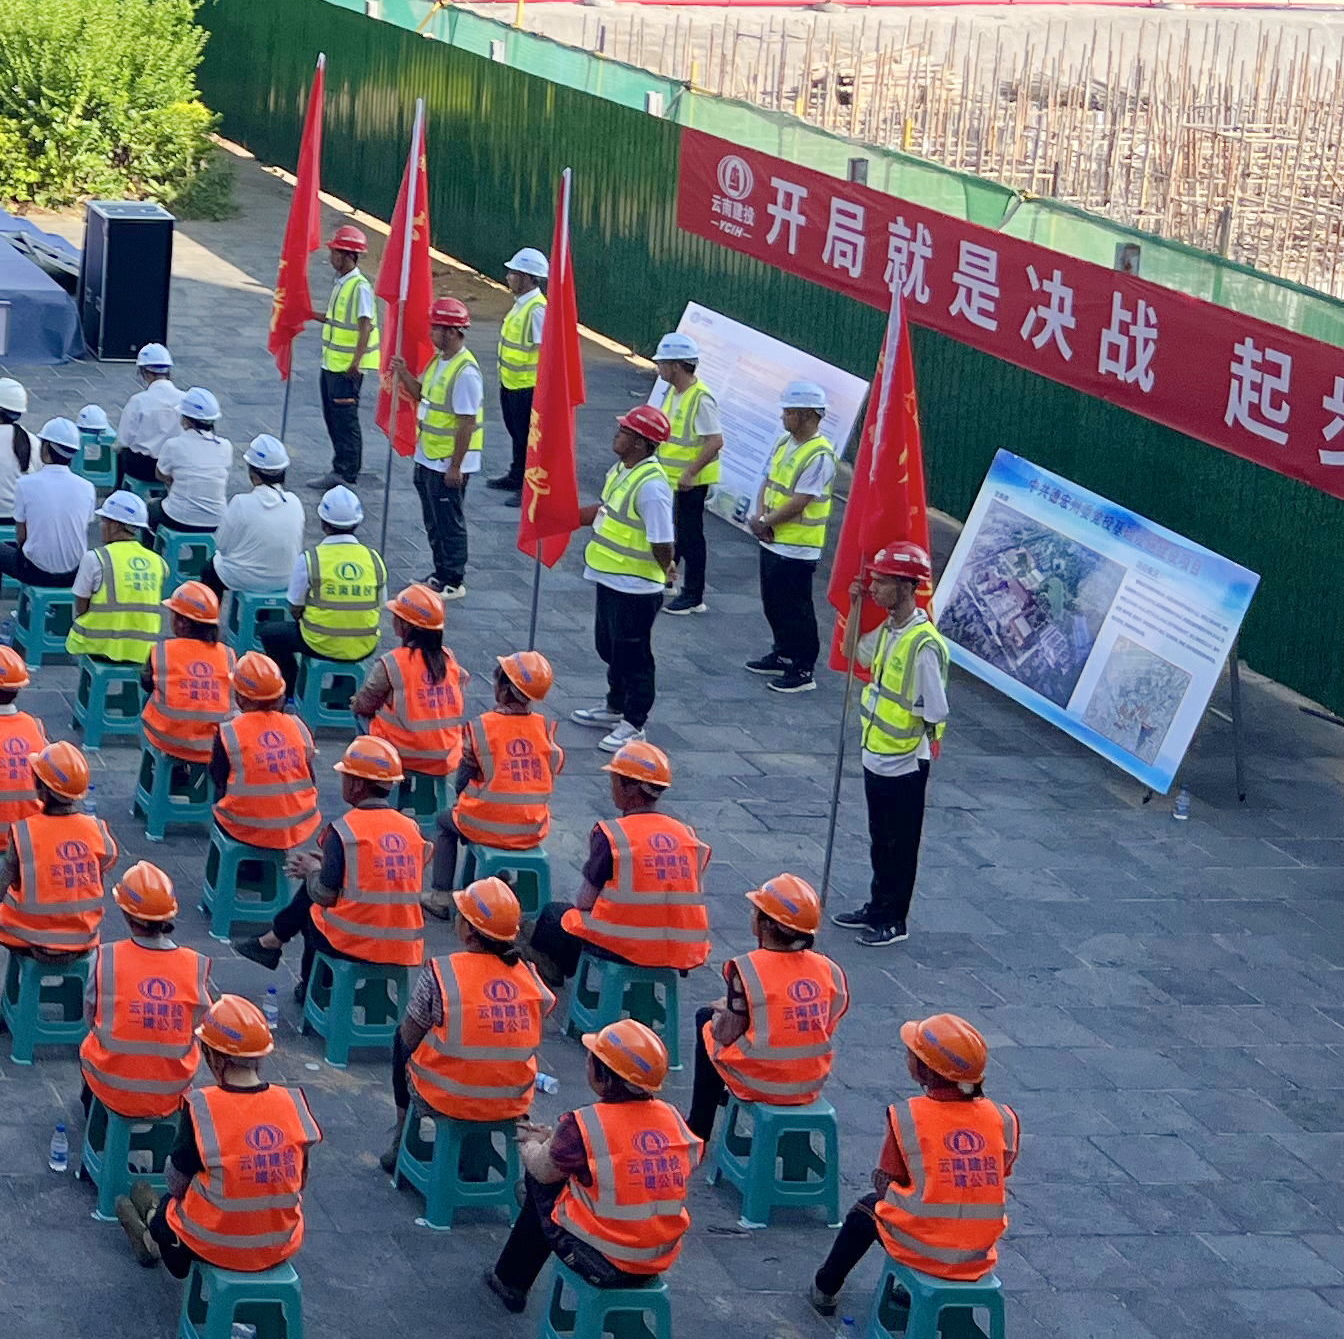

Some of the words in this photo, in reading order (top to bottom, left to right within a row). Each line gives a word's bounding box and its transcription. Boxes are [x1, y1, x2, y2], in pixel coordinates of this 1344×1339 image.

[711, 194, 755, 227] 云南建投
[766, 176, 1159, 393] 开局就是决战
[325, 585, 373, 597] 云南建投
[628, 1156, 681, 1174] 云南建投
[940, 1156, 997, 1173] 云南建投
